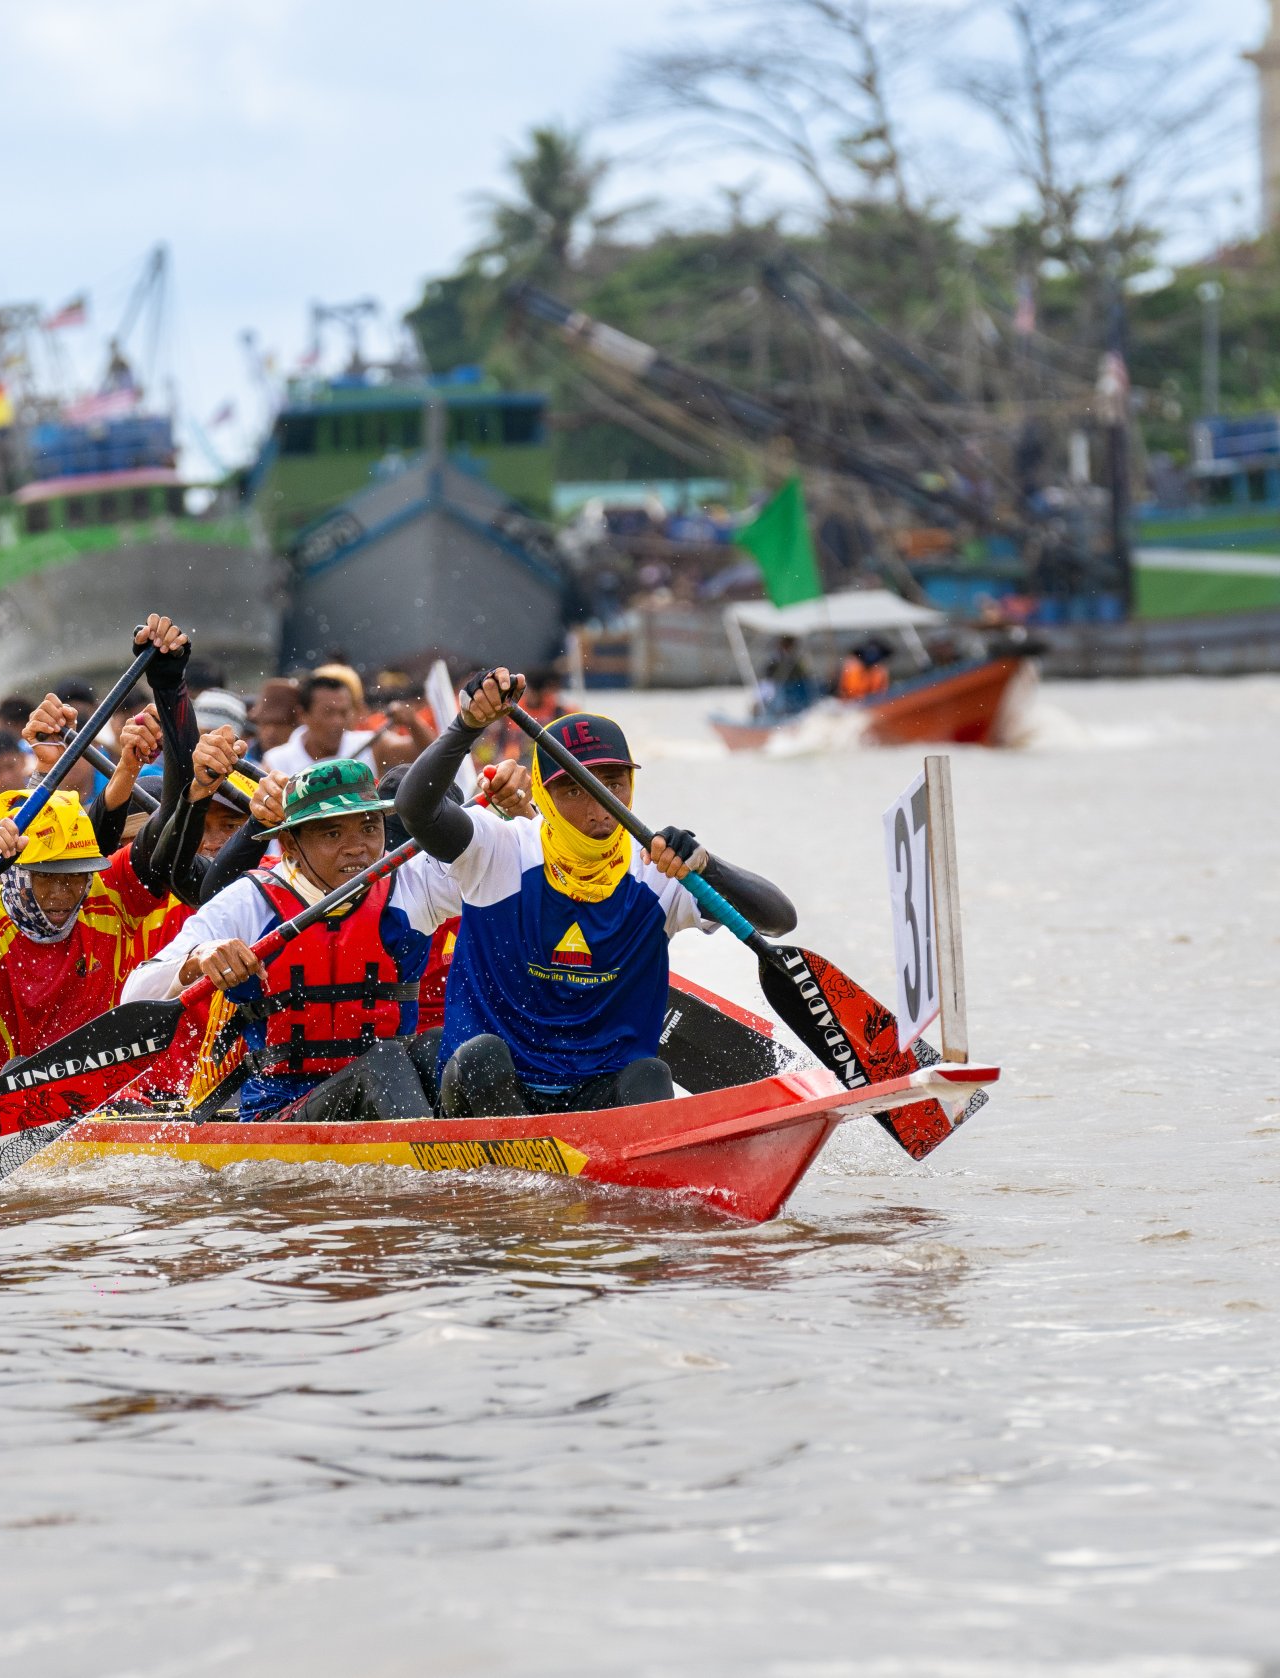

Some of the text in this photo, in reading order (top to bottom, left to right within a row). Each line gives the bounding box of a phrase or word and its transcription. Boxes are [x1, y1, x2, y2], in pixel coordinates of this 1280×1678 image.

[561, 721, 601, 749] I.E.
[895, 782, 934, 1023] 37
[6, 1036, 163, 1091] KINGPADDLE
[782, 949, 867, 1090] INGPADDLE
